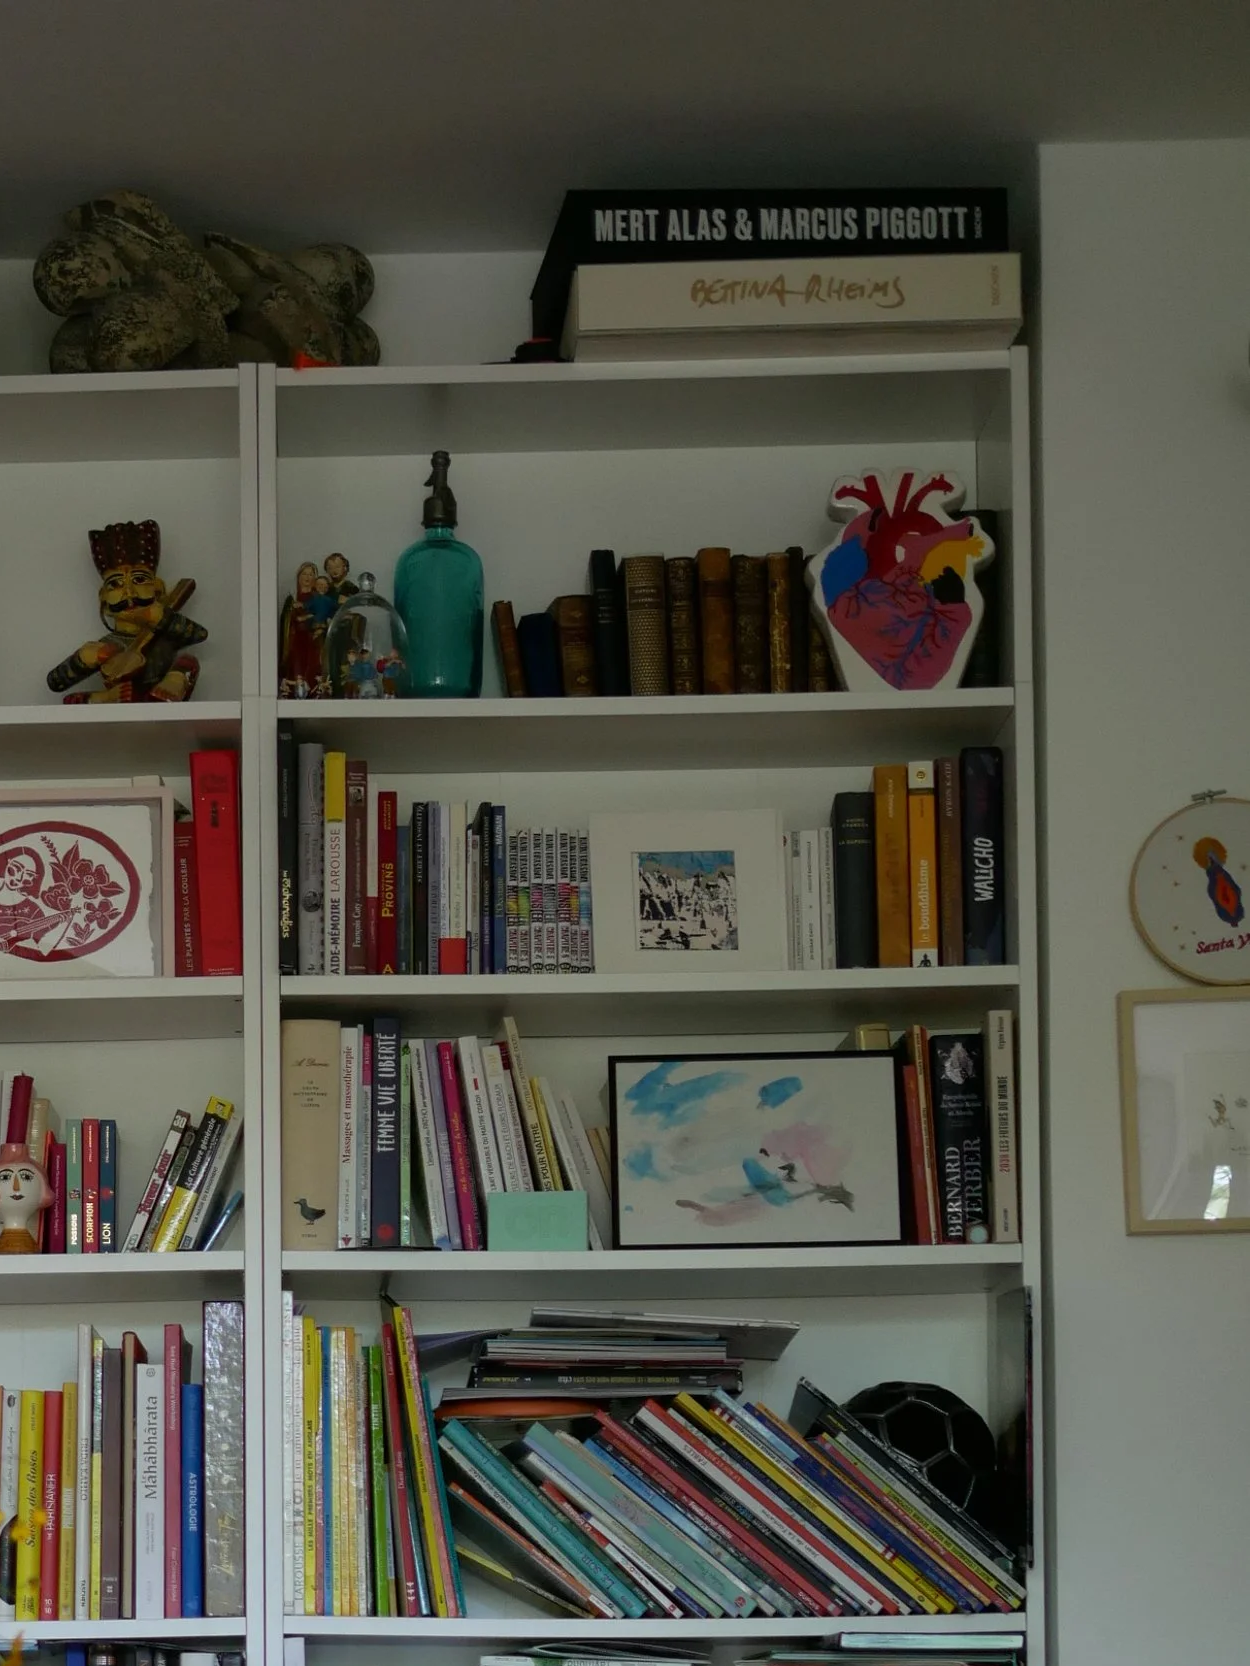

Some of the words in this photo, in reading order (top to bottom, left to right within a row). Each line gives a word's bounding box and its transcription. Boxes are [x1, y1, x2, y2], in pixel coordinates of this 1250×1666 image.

[594, 208, 658, 242] MERT
[668, 208, 728, 240] ALAS
[734, 207, 752, 240] &
[760, 206, 858, 240] MARCUS
[865, 205, 968, 240] PIGGOTT
[495, 814, 504, 844] MAGNAN
[180, 858, 188, 894] COULEUR
[329, 829, 342, 892] LAROUSSE
[381, 863, 394, 918] PROVINS
[558, 882, 572, 922] MONSTER
[918, 859, 930, 930] bouddhisme
[184, 923, 192, 958] PLANTES
[327, 898, 342, 974] AIDE-MÉMOIRE
[1196, 938, 1224, 954] Santa
[186, 959, 194, 972] LES
[375, 1032, 396, 1078] LIBERTÉ
[341, 1046, 354, 1110] massothérapie
[377, 1084, 396, 1106] VIE
[198, 1117, 218, 1150] générale
[343, 1111, 352, 1120] et
[377, 1111, 396, 1152] FEMME
[342, 1122, 352, 1164] Massages
[188, 1150, 206, 1176] Culture
[183, 1176, 194, 1188] La
[944, 1147, 964, 1238] BERNARD
[963, 1137, 984, 1226] VERBER
[86, 1202, 96, 1244] SCORPION
[102, 1222, 112, 1246] LION
[26, 1450, 38, 1482] Roses
[188, 1472, 198, 1532] ASTROLOGIE
